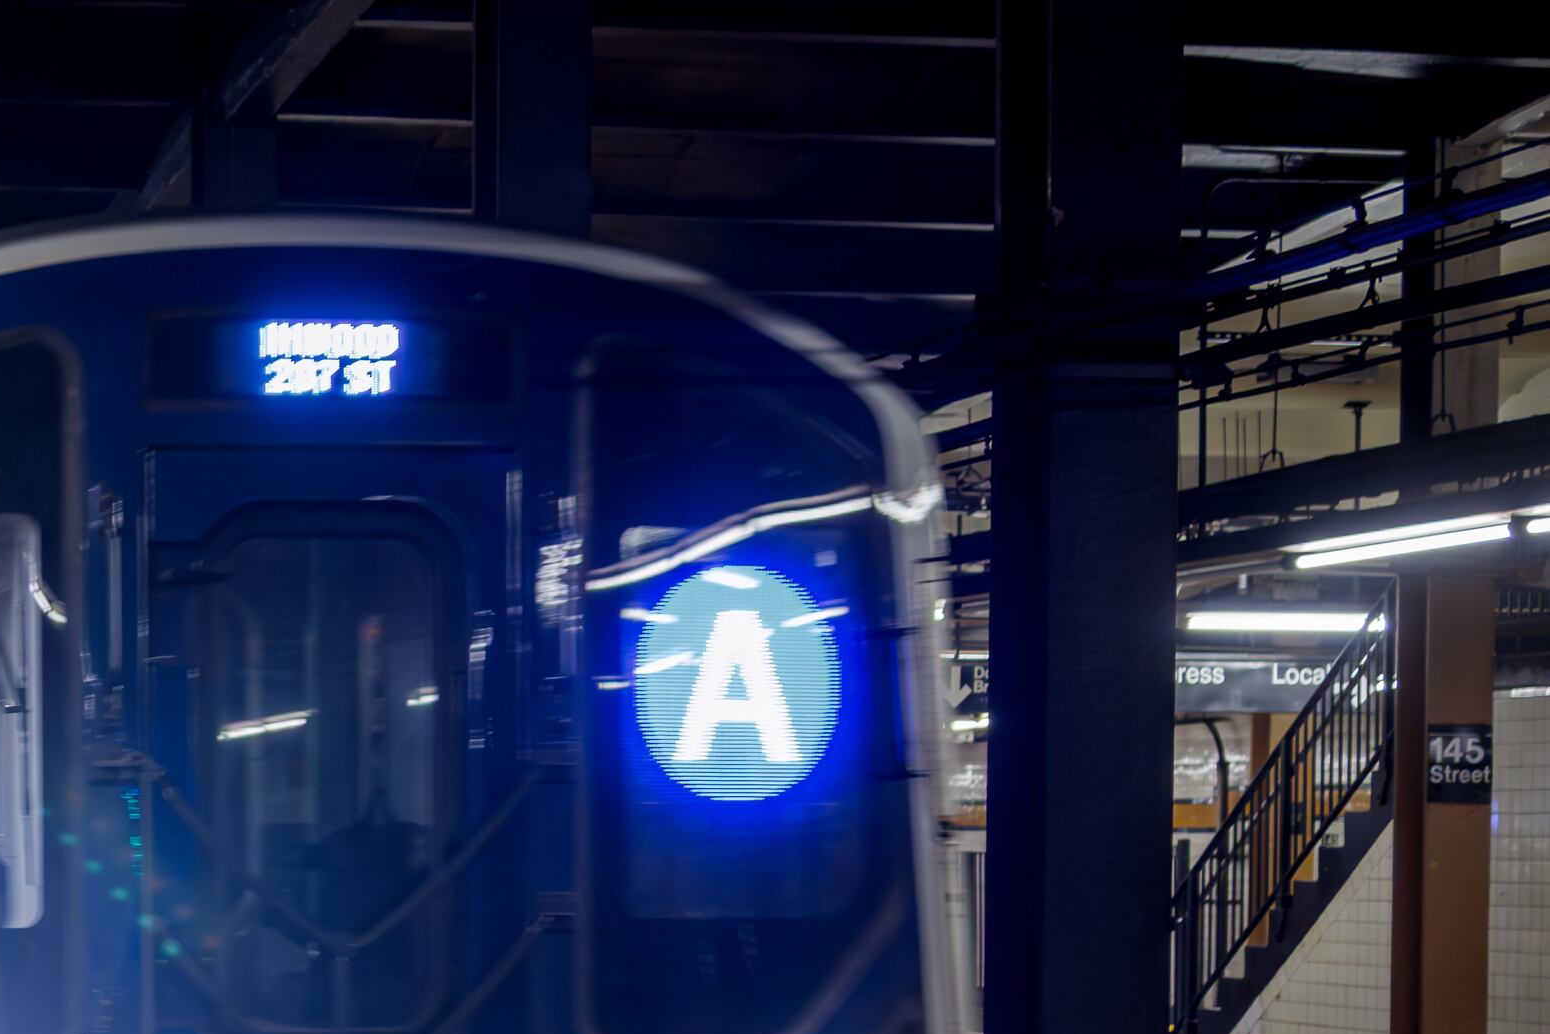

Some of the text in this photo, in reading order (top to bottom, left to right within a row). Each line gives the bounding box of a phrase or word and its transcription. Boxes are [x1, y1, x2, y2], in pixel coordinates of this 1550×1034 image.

[343, 360, 397, 395] ST
[671, 610, 803, 762] A
[1175, 666, 1225, 686] ress
[1429, 736, 1485, 764] 145
[1429, 764, 1491, 785] Street
